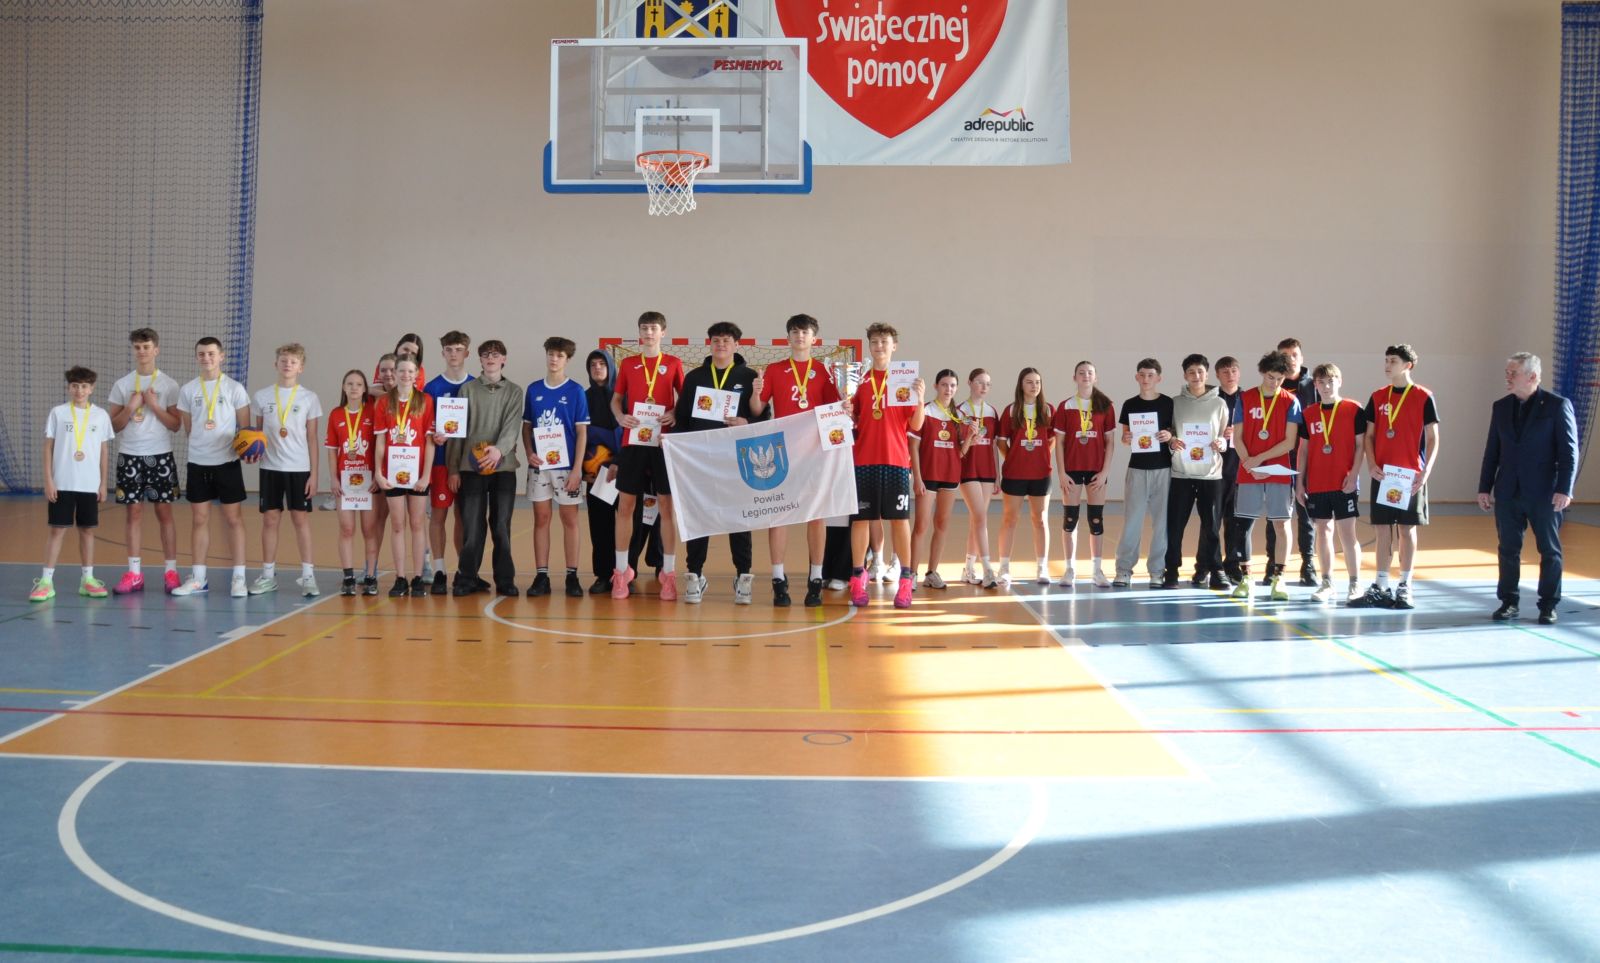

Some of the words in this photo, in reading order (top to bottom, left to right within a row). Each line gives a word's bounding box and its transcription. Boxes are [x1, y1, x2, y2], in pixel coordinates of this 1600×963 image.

[712, 59, 783, 71] PESMENPOL
[847, 58, 947, 100] pomocy
[964, 118, 1034, 134] adrepublic
[820, 410, 845, 419] DYPLOM
[1249, 407, 1263, 420] 10
[1378, 403, 1391, 416] 19
[941, 421, 947, 430] 9
[1310, 421, 1323, 434] 13
[1386, 472, 1411, 480] DYPLOM
[753, 492, 785, 504] Powiat
[896, 494, 909, 511] 34
[742, 500, 800, 518] Legionowski
[1347, 499, 1355, 512] 2
